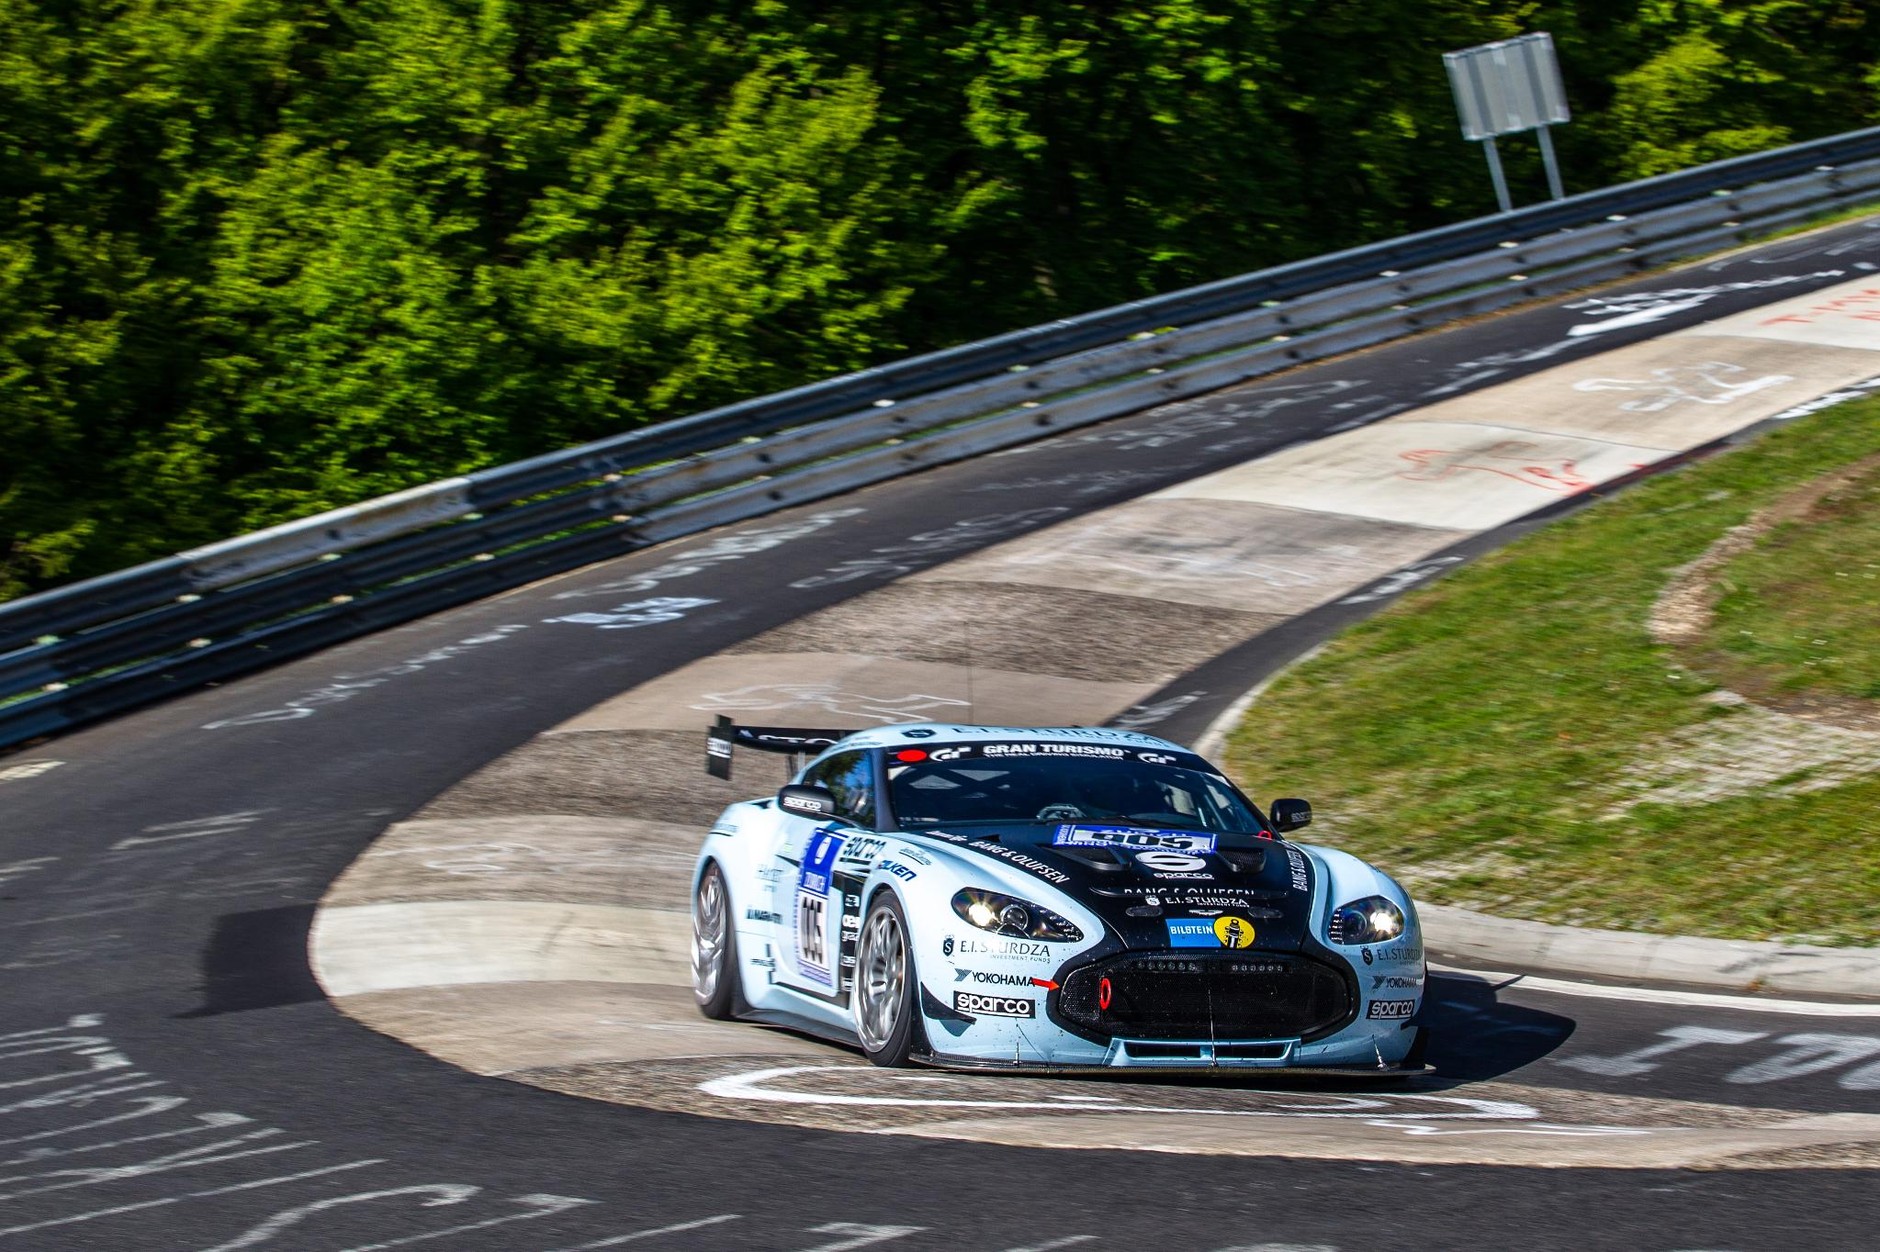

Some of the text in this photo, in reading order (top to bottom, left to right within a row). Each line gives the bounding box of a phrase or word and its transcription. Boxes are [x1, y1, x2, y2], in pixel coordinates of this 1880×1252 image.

[983, 744, 1124, 757] GRAN TURISMO
[968, 841, 1070, 883] BANG & OLUFSEN
[1153, 872, 1214, 880] sparco
[1165, 896, 1248, 906] E.I. STURDZA
[1169, 925, 1214, 935] BILSTEIN
[960, 940, 977, 953] E.I.
[1030, 956, 1051, 964] FUNDS
[1377, 948, 1391, 961] E.I.
[972, 971, 1036, 988] YOKOHAMA
[957, 993, 1030, 1015] sparco
[1372, 1001, 1414, 1019] sparco
